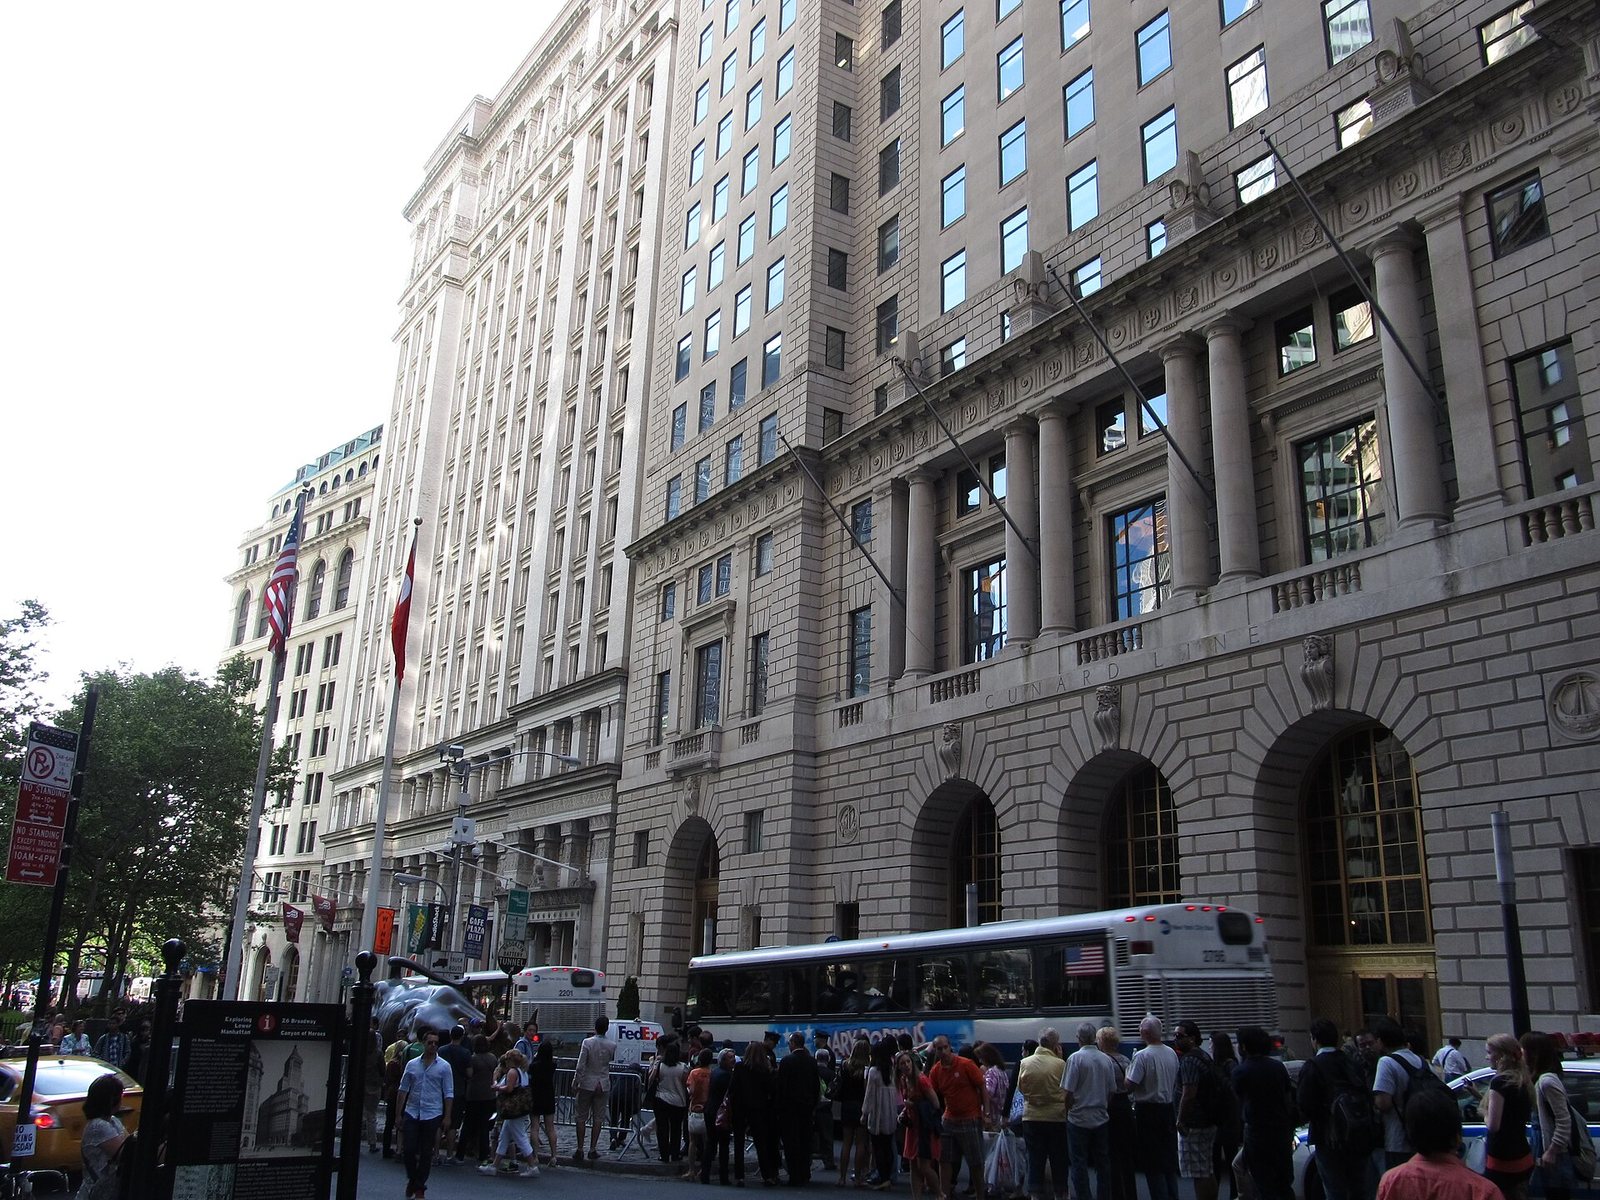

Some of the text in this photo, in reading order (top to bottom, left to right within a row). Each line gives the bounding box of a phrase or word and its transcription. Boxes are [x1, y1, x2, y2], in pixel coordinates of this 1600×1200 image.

[985, 626, 1260, 710] CUNARD LINE
[23, 783, 66, 798] NO STANDING
[16, 826, 60, 840] NO STANDING
[17, 837, 57, 849] EXCEPT TRUCKS
[14, 851, 55, 864] 10AM-4PM
[431, 905, 440, 941] RadioShack
[469, 917, 485, 927] CAFE
[467, 925, 485, 935] PLAZA
[467, 933, 482, 942] DELI
[499, 957, 525, 966] TUNNEL
[559, 989, 574, 997] 2201
[225, 1016, 253, 1024] Exploring
[280, 1030, 300, 1038] Canyon
[618, 1026, 660, 1041] FedEx
